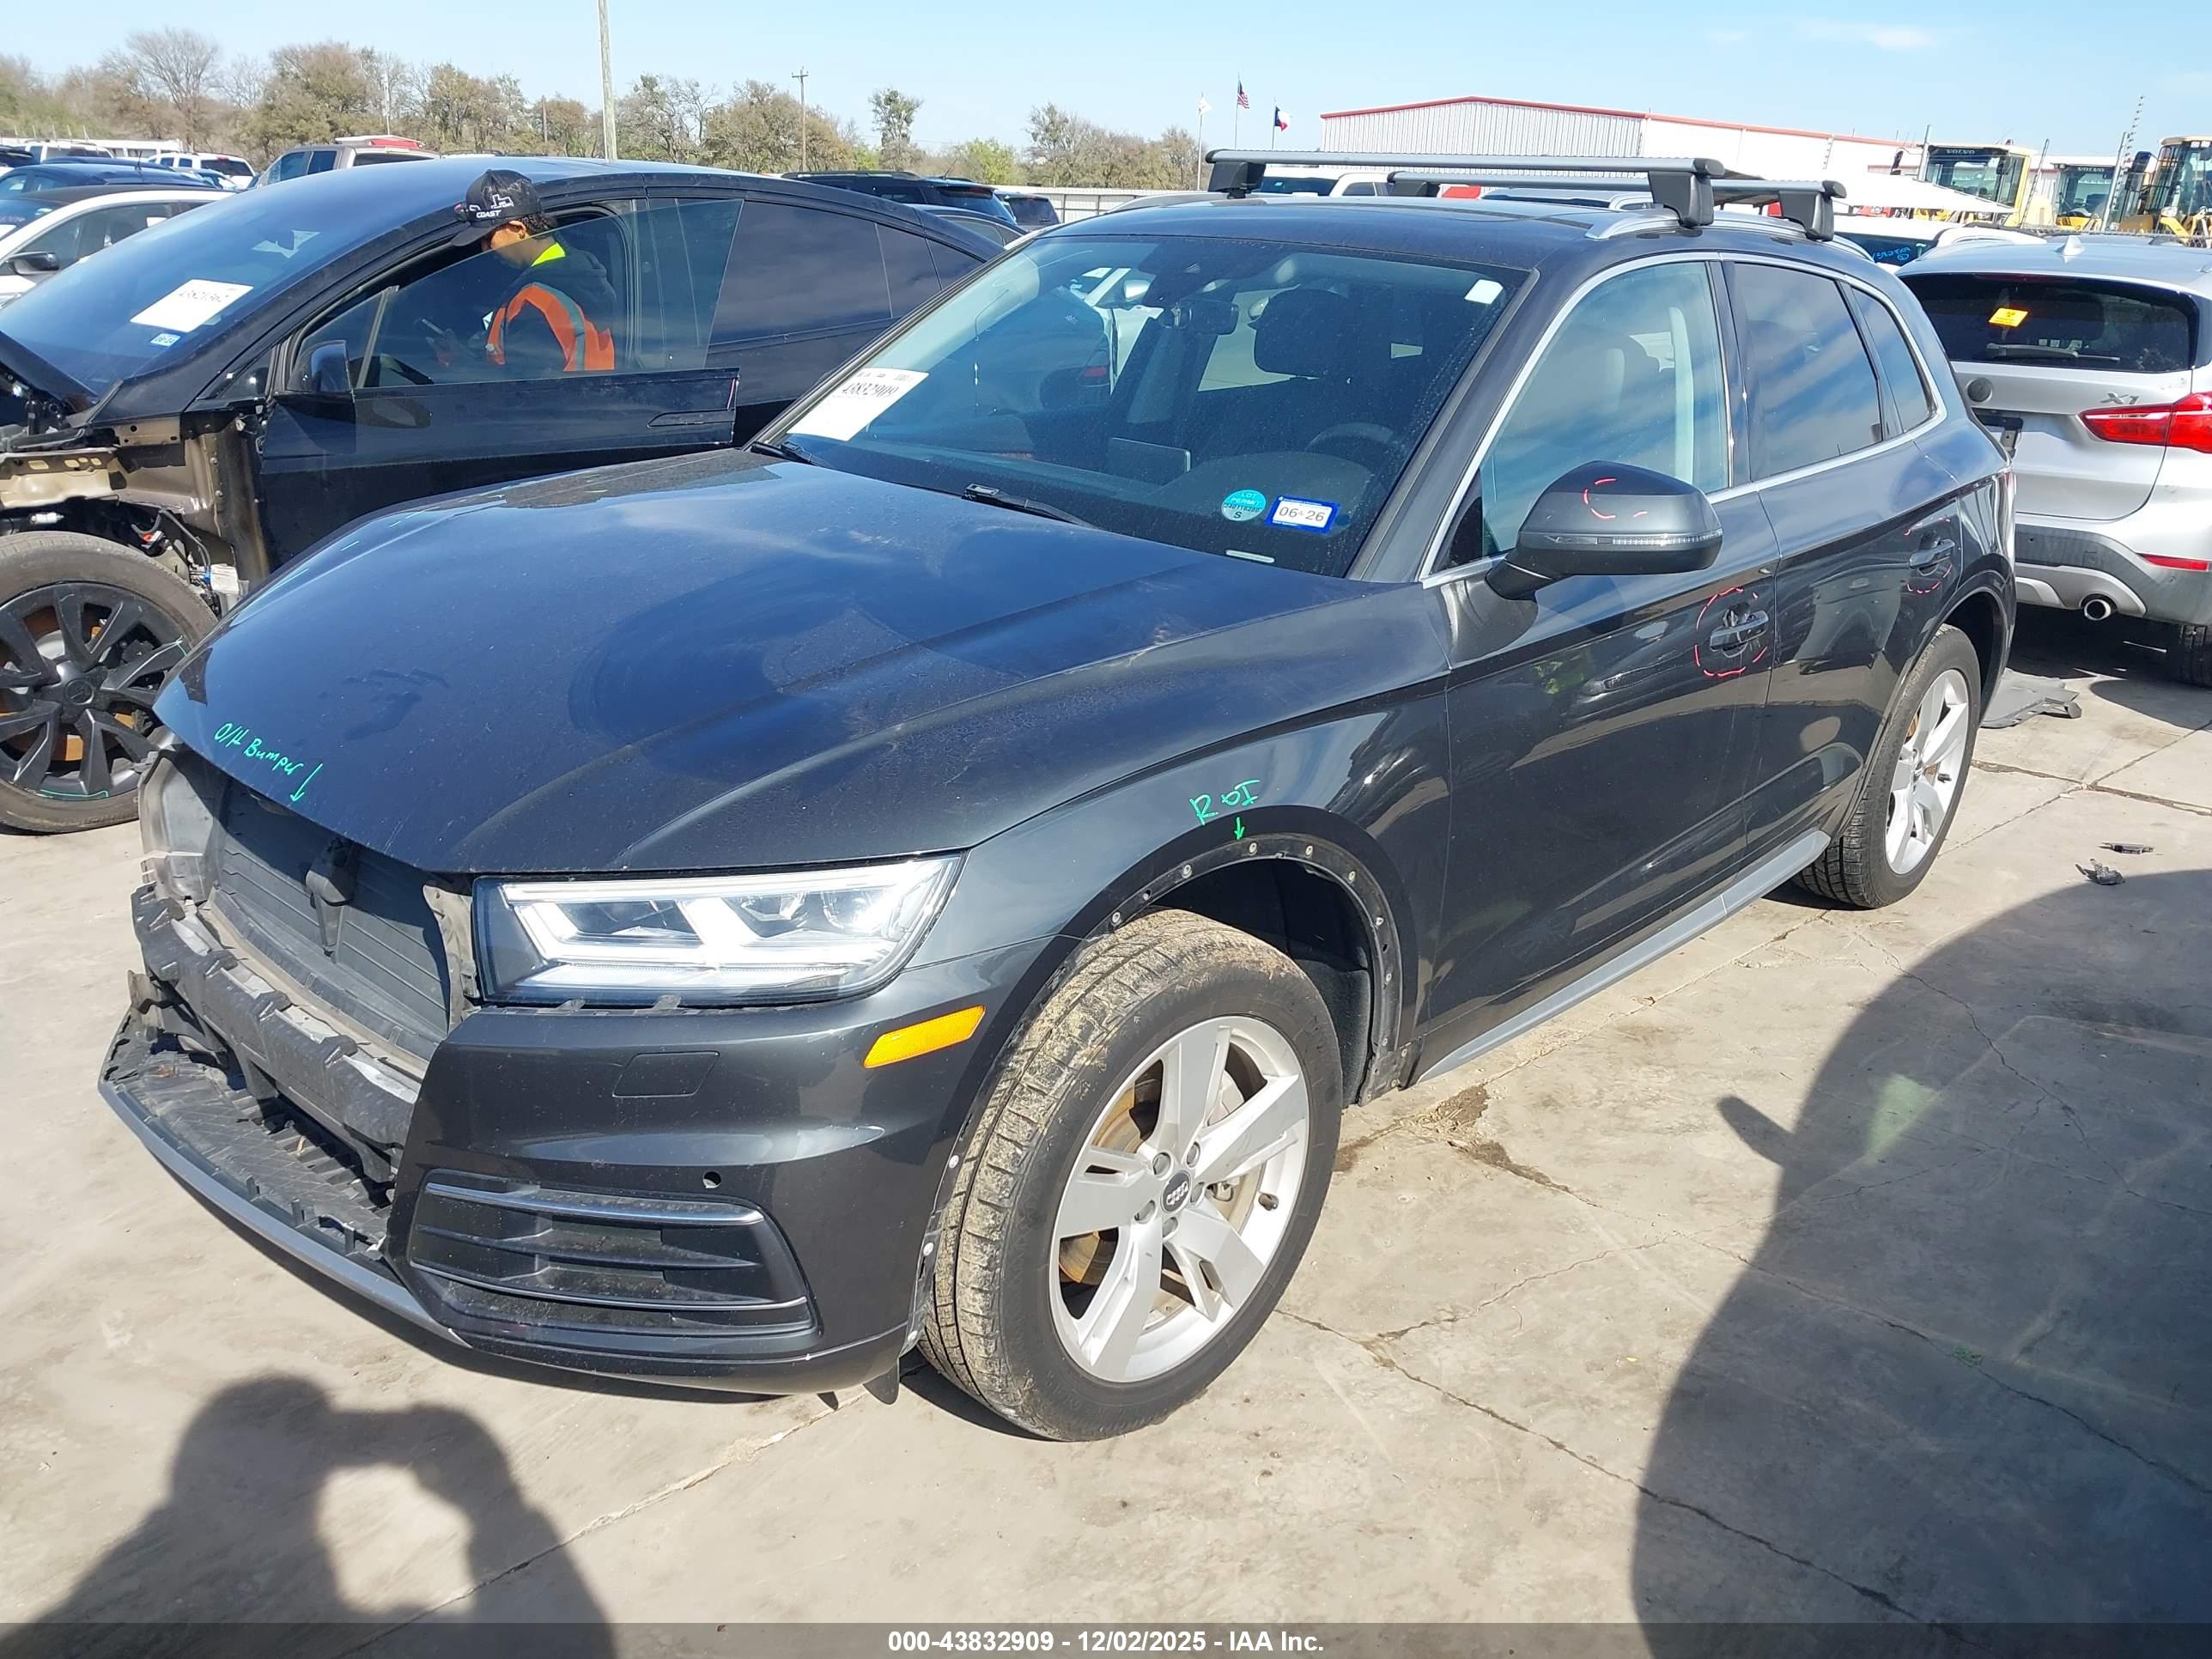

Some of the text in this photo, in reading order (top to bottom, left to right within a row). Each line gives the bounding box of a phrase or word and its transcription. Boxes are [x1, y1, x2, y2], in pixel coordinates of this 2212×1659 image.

[476, 210, 501, 218] COAST
[2100, 392, 2140, 404] X1
[1230, 497, 1260, 506] PERMIT
